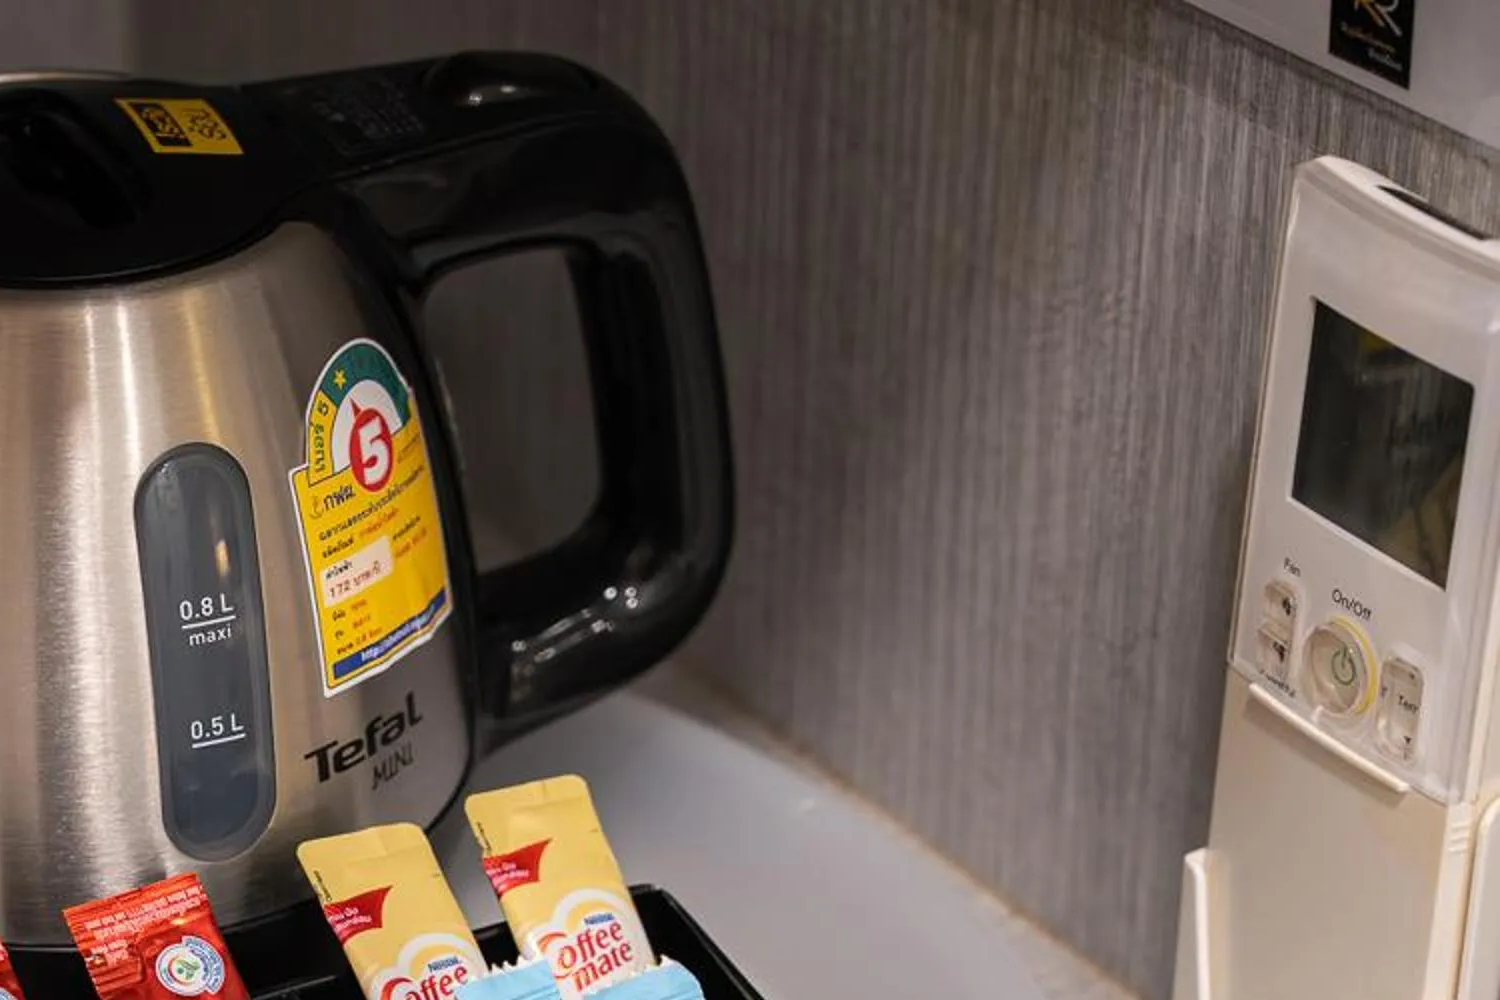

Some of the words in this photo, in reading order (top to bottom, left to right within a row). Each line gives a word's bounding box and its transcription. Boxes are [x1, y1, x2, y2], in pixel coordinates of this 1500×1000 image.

[356, 415, 391, 487] 5
[179, 596, 214, 621] 0.8
[219, 593, 235, 614] L
[1331, 588, 1372, 620] On/Off
[188, 624, 232, 647] maxi
[190, 715, 225, 740] 0.5
[230, 712, 245, 733] L
[304, 690, 423, 783] Tefal
[572, 942, 633, 992] mate
